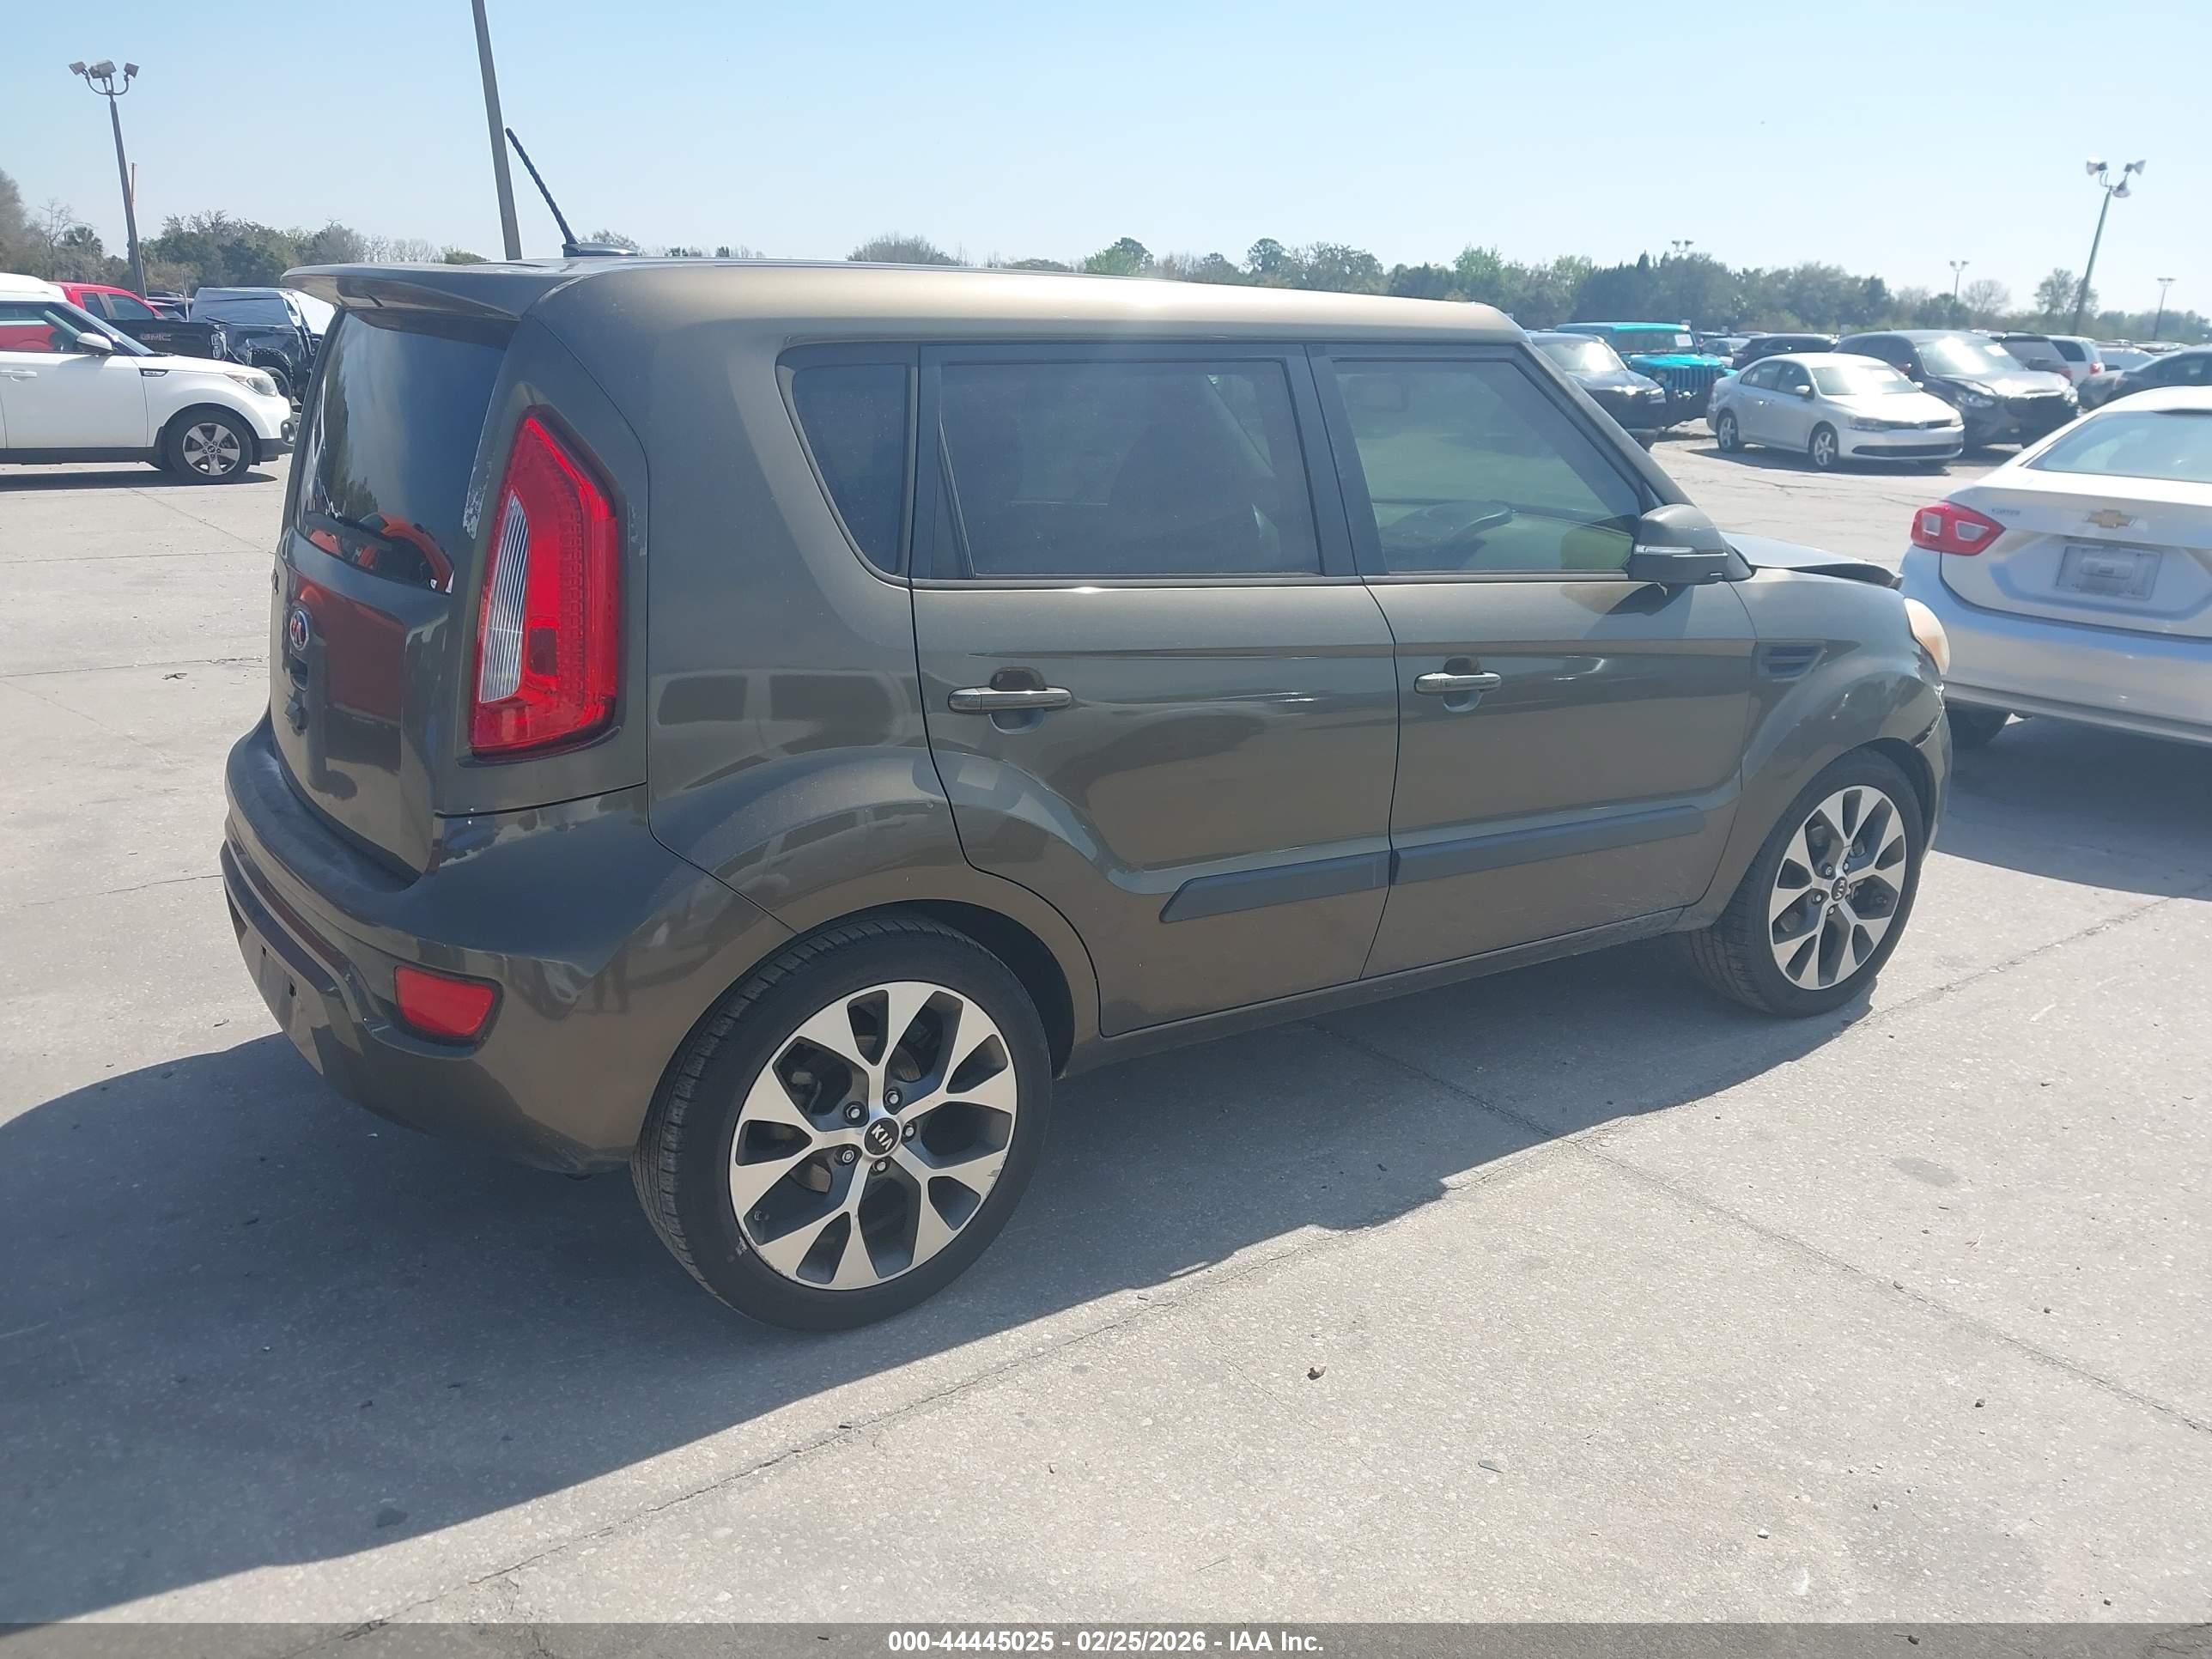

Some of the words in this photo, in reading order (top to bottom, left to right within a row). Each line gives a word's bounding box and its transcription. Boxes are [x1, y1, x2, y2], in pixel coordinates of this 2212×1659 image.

[140, 333, 172, 342] GMC
[1835, 879, 1845, 900] KIA
[871, 1123, 893, 1151] KIA
